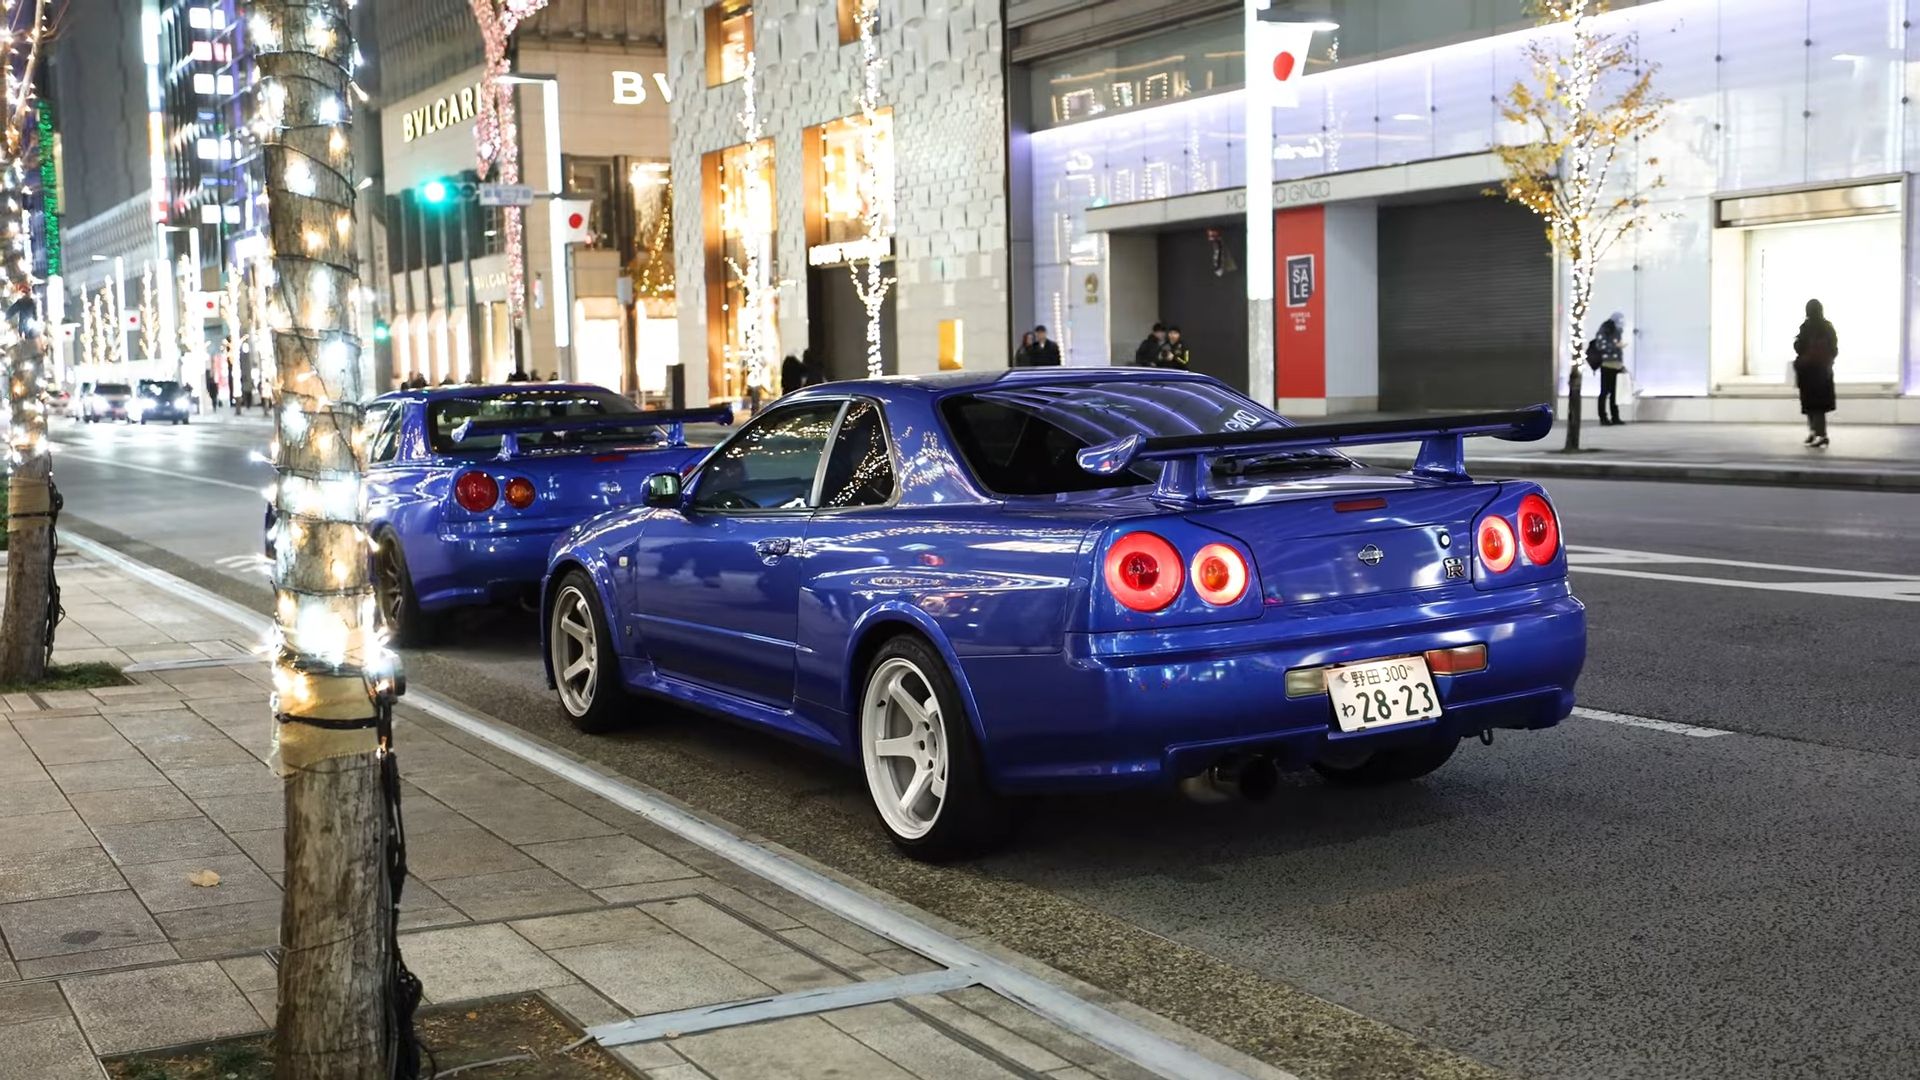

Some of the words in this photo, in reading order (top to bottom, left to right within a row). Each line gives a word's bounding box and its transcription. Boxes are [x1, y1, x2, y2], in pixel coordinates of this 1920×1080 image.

[403, 82, 482, 142] BVLGARI
[1382, 664, 1408, 682] 300
[1356, 682, 1434, 723] 28-23
